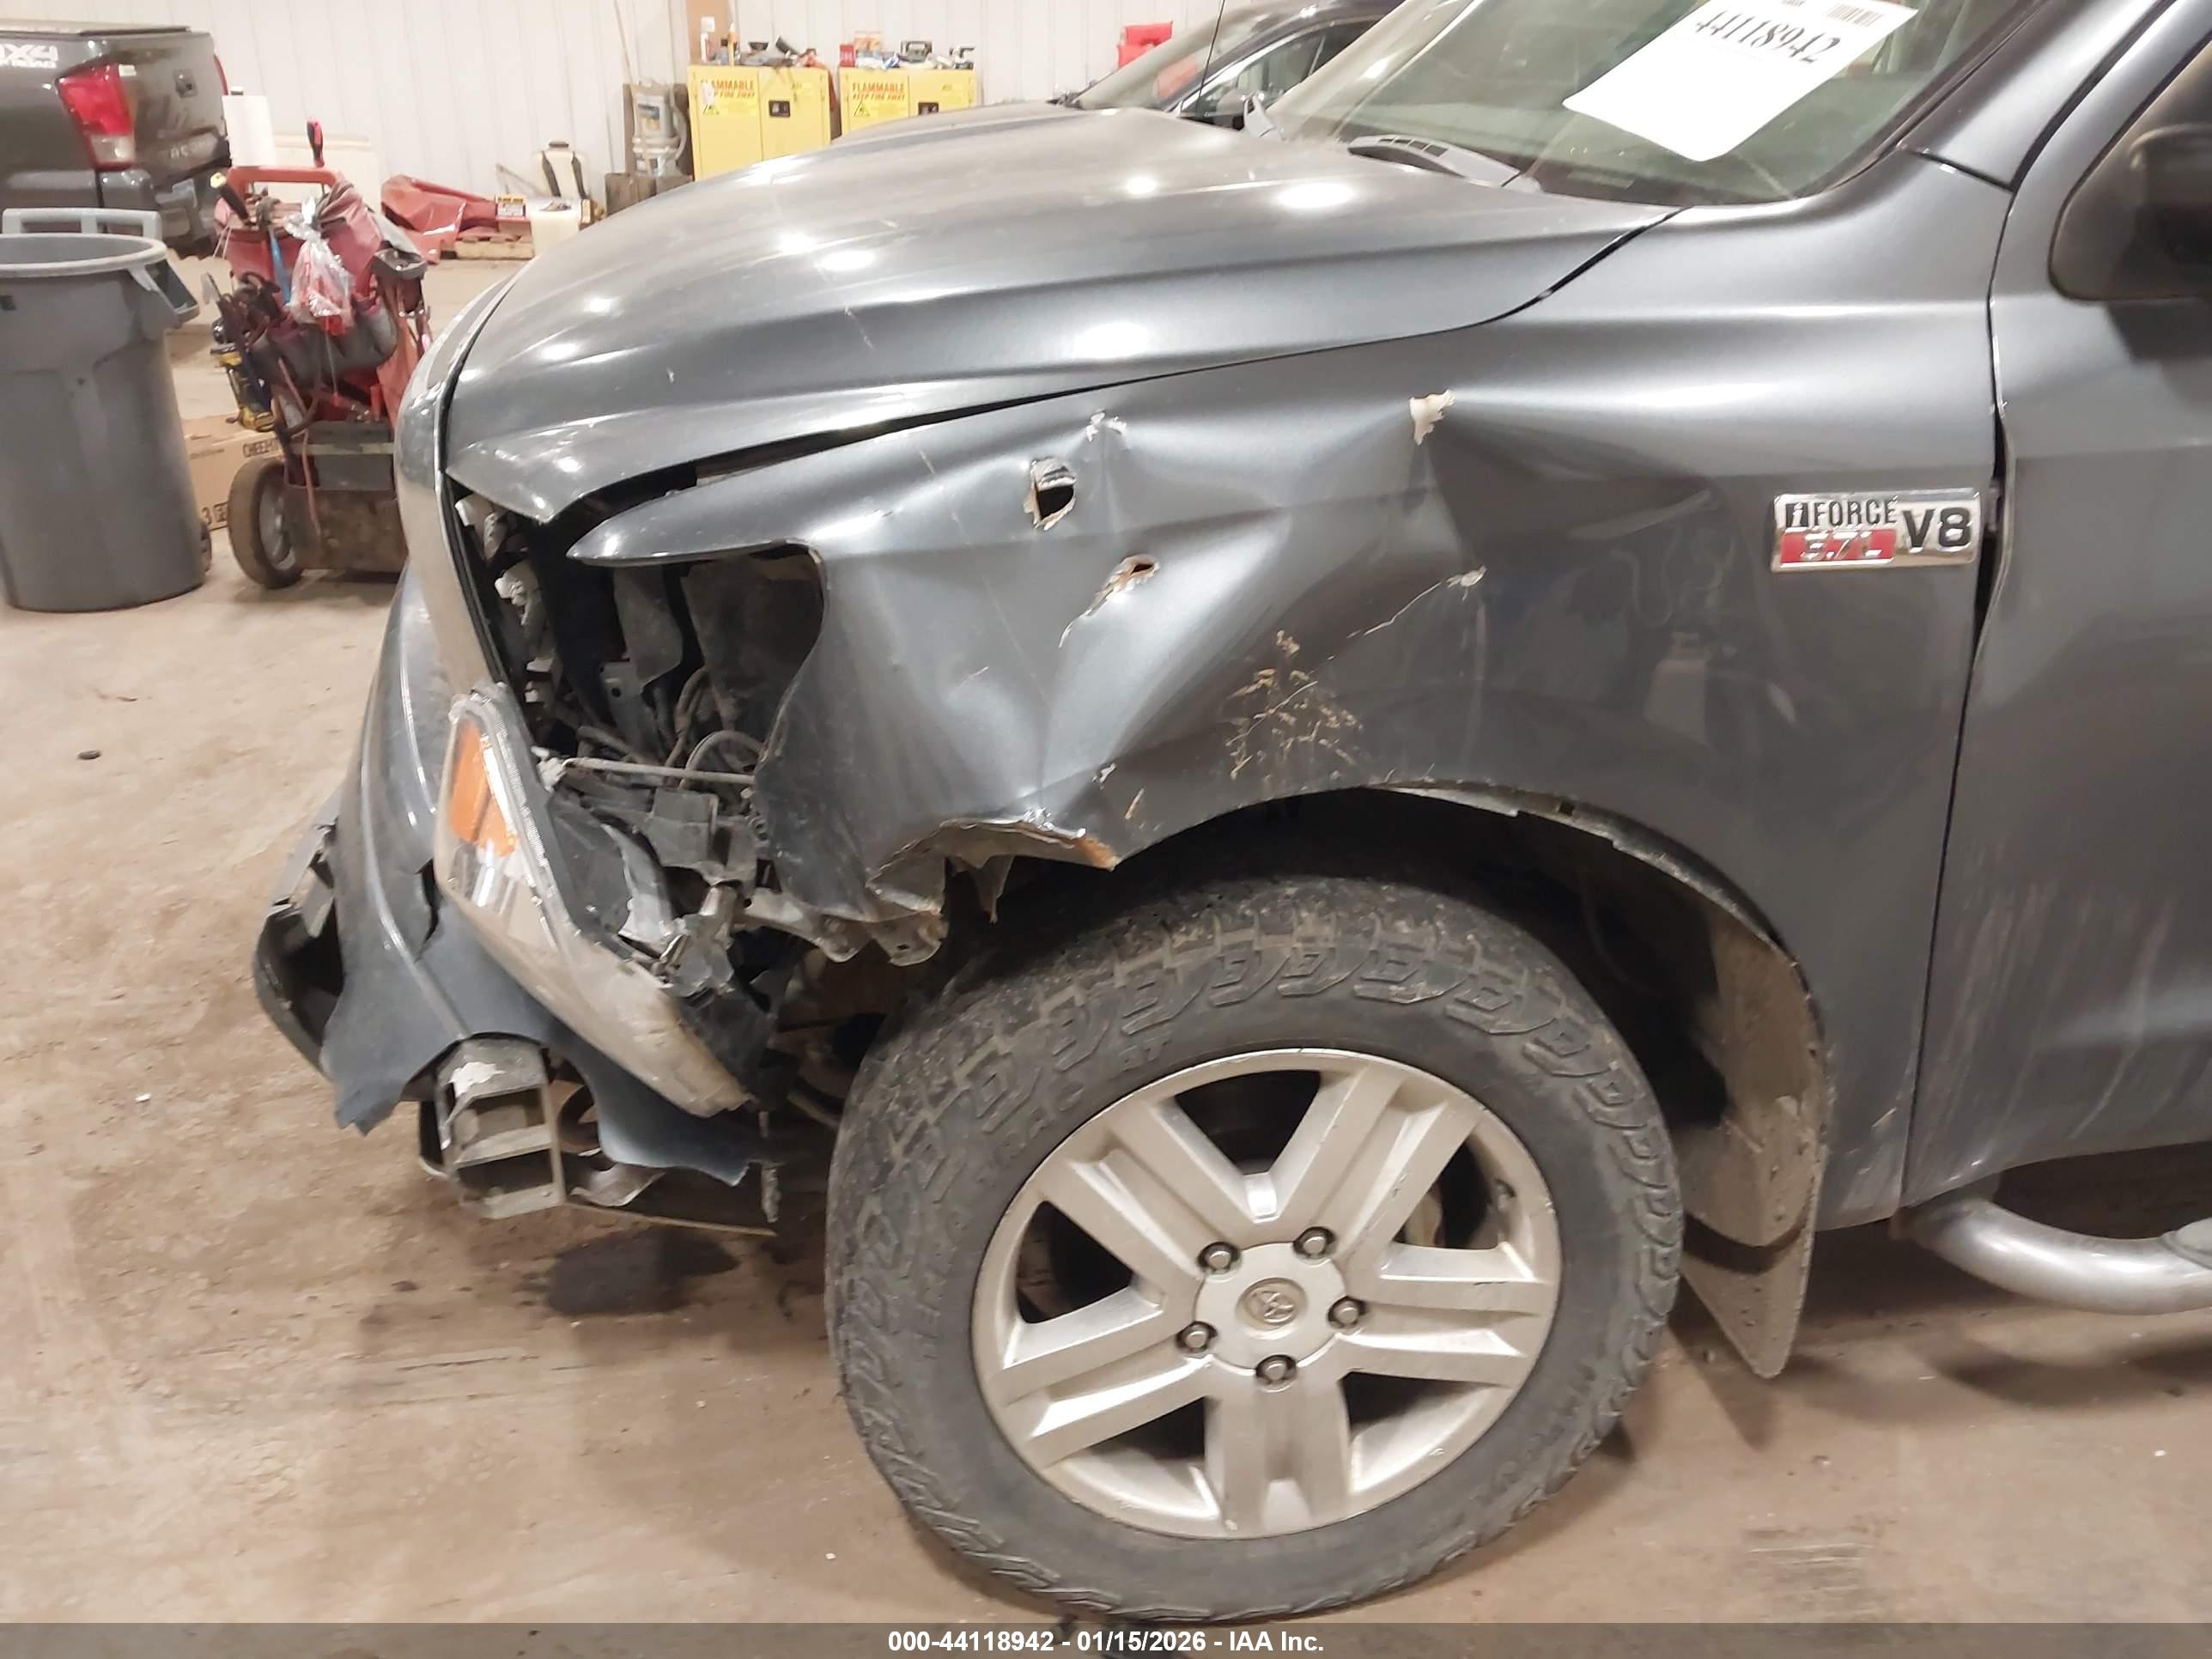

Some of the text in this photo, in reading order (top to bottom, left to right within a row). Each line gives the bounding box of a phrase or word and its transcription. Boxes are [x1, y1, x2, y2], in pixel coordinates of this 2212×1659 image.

[0, 43, 58, 62] X4
[1696, 10, 1840, 63] 44118942
[1902, 507, 1972, 552] V8
